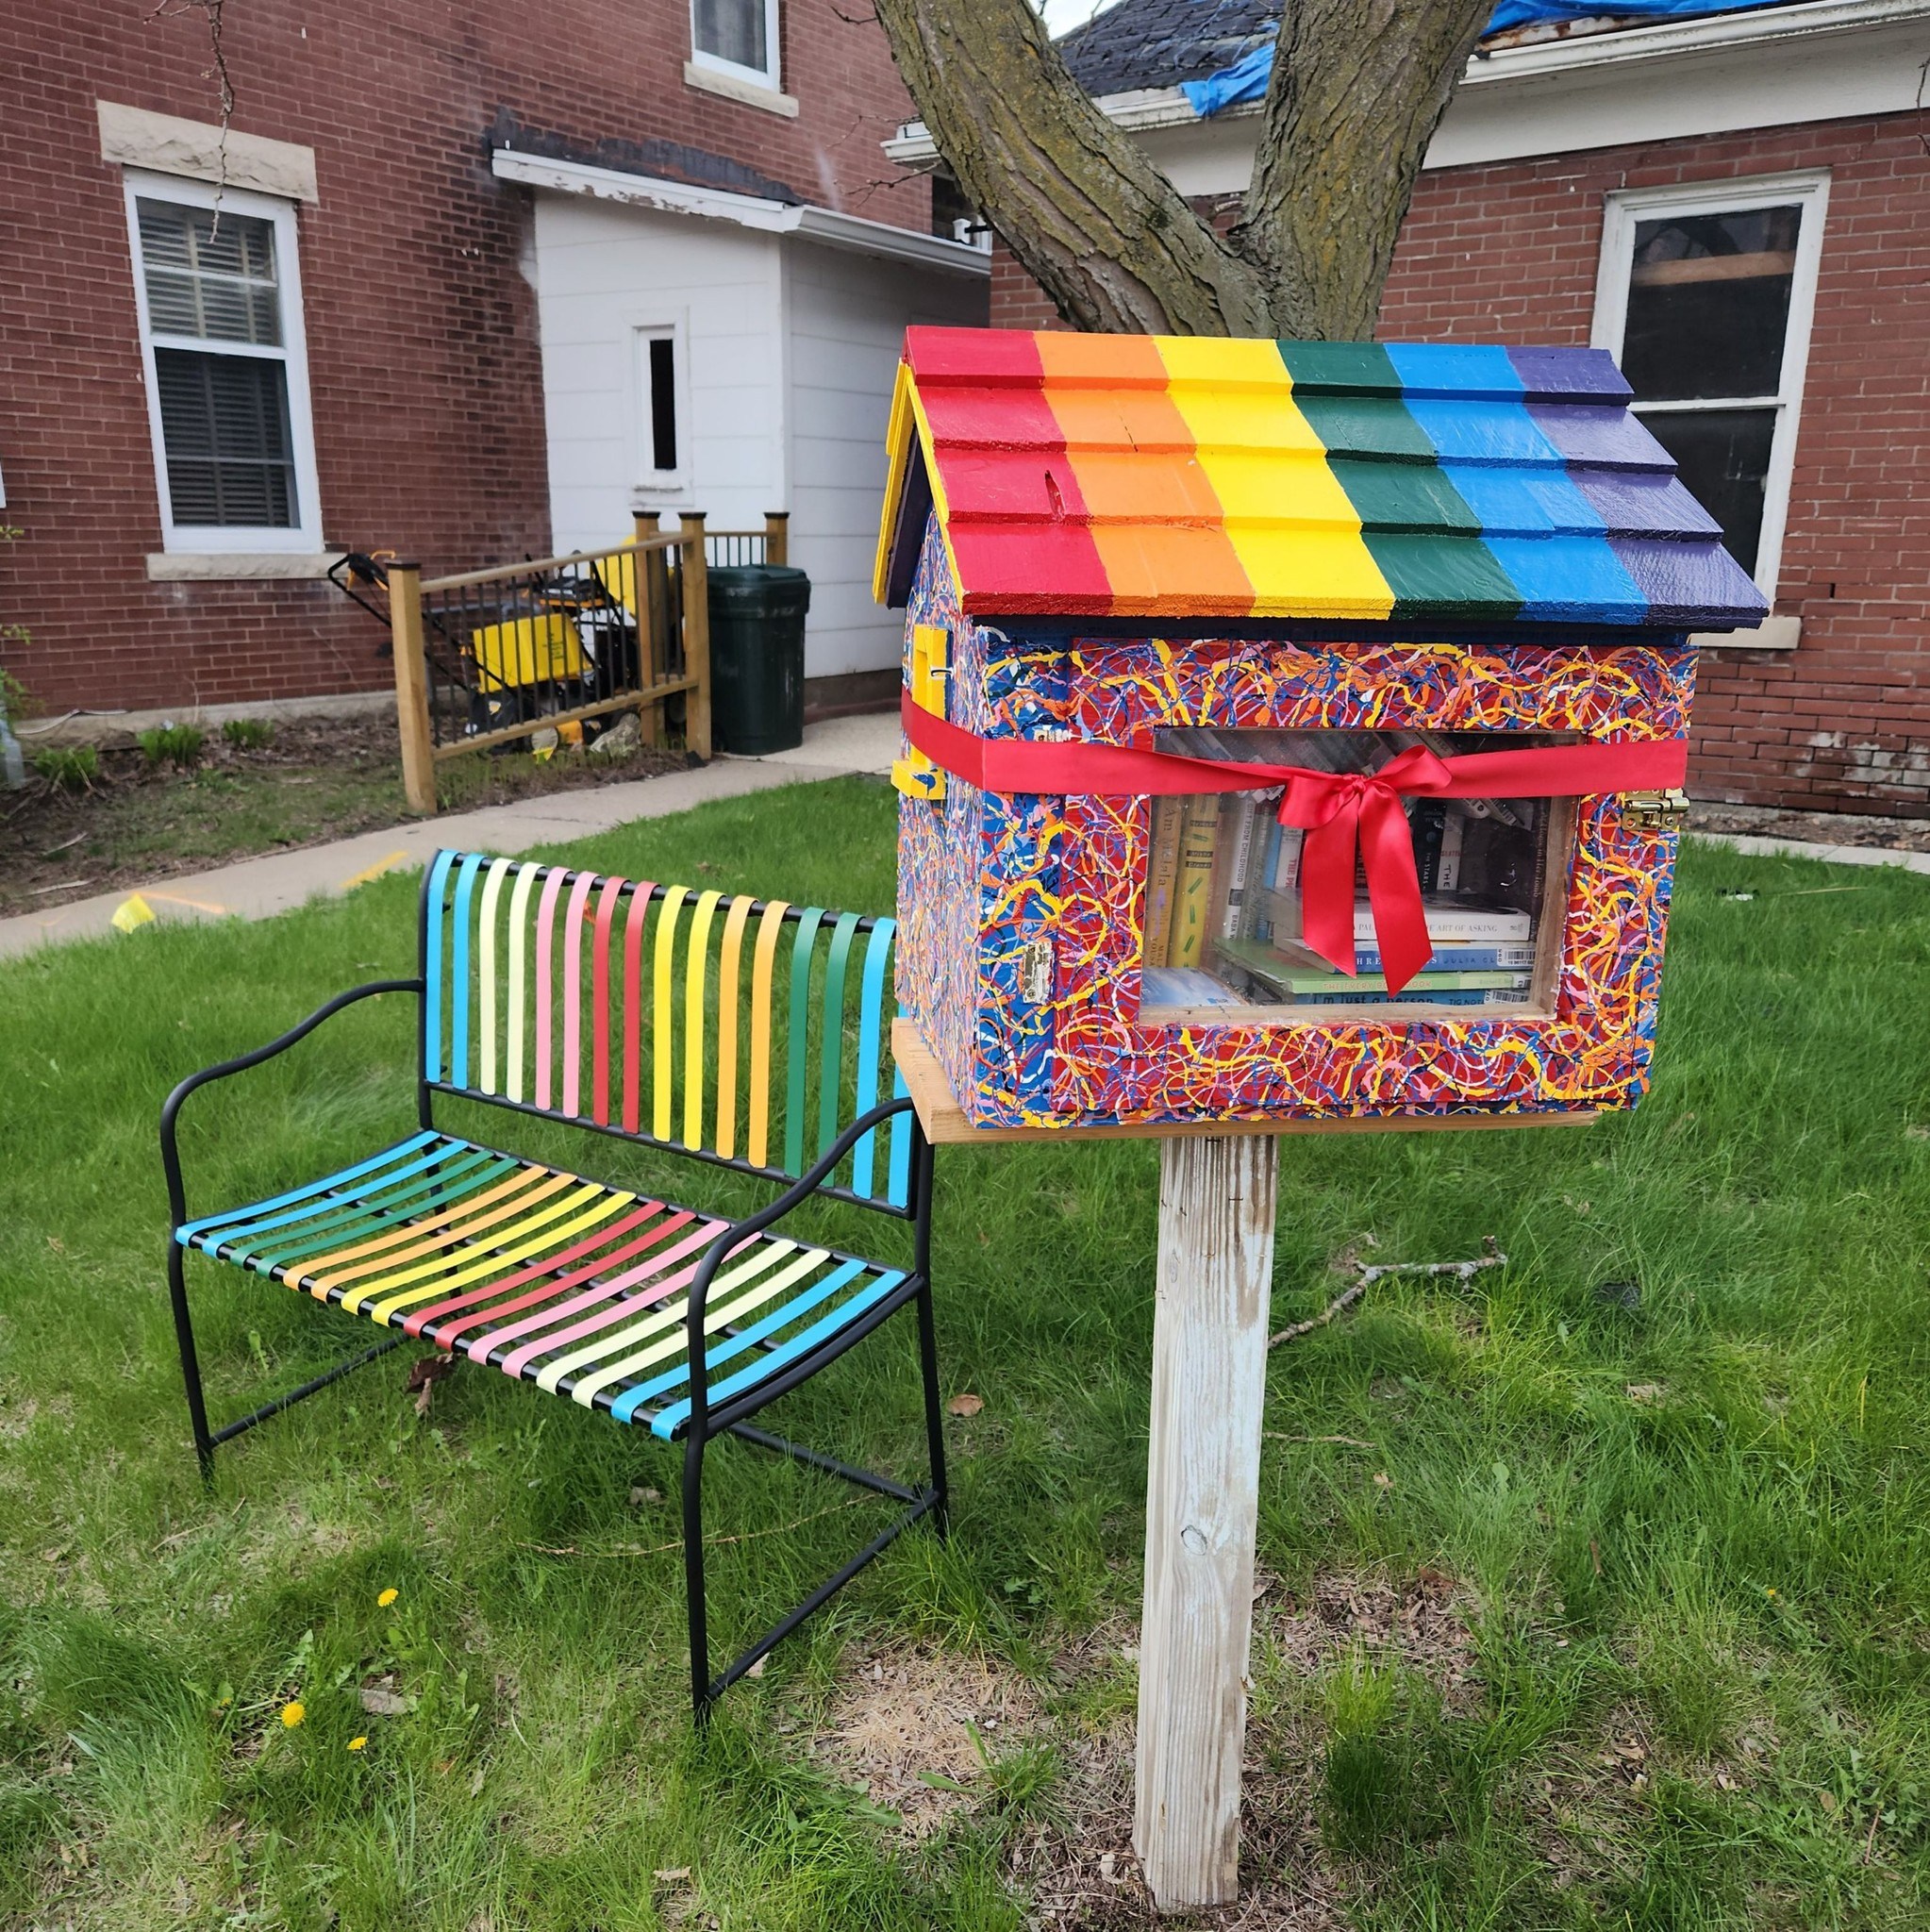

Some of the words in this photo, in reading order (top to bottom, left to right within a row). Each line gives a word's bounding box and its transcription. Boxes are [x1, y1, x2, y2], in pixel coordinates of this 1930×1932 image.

[1163, 808, 1176, 831] Am
[1243, 821, 1252, 841] FROM
[1237, 842, 1249, 883] CHILDHOOD
[1287, 858, 1298, 875] THE
[1422, 862, 1431, 885] STARS
[1442, 863, 1453, 889] THE
[1230, 914, 1239, 932] BABA
[1358, 923, 1374, 932] PAL
[1436, 923, 1452, 932] ART
[1454, 923, 1466, 932] OF
[1469, 923, 1498, 933] ASKING
[1148, 937, 1158, 968] YOUSA
[1356, 957, 1382, 966] HRE
[1323, 982, 1340, 991] THE
[1344, 981, 1373, 991] EVERY
[1340, 993, 1366, 1005] just
